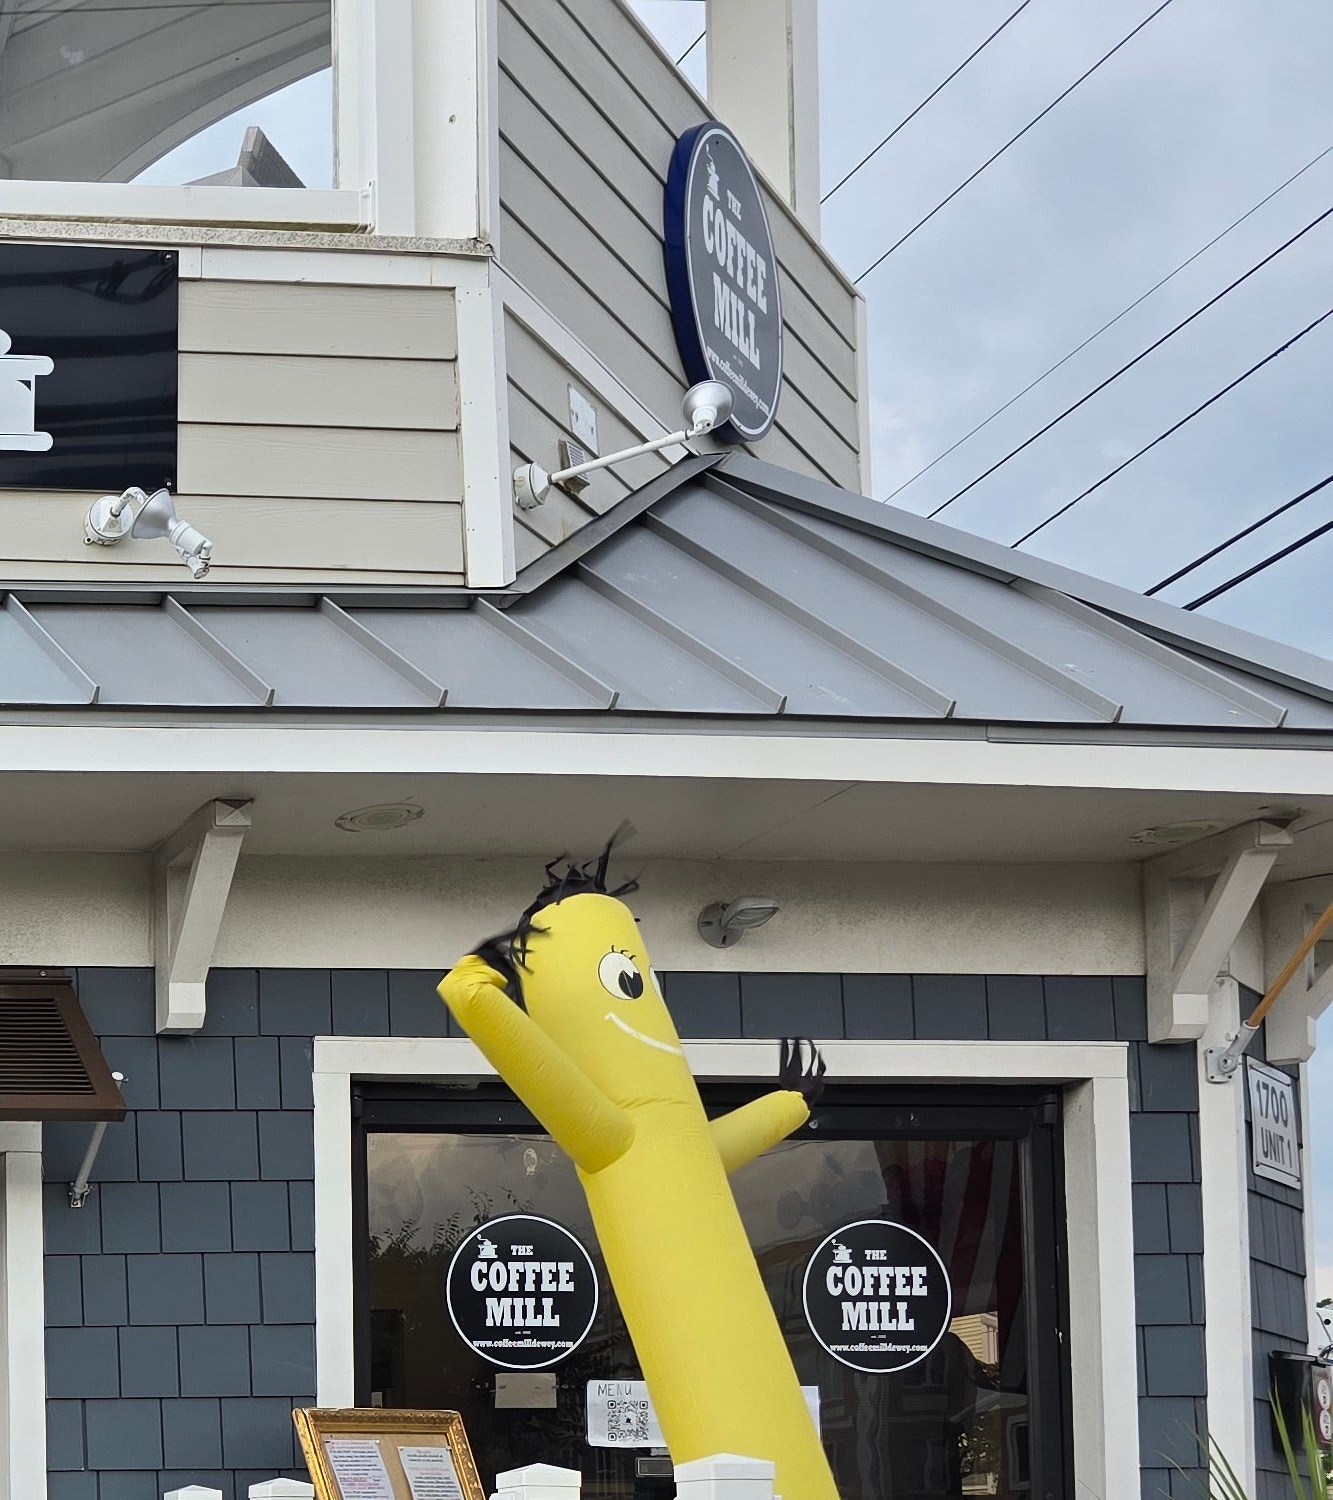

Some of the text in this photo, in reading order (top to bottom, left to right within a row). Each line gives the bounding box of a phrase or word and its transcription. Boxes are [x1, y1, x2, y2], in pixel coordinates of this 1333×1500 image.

[726, 188, 742, 221] THE
[702, 194, 768, 315] COFFEE
[712, 271, 761, 371] MILL
[1256, 1079, 1289, 1128] 1700
[1261, 1127, 1293, 1169] UNIT 1
[510, 1245, 534, 1255] THE
[864, 1250, 887, 1260] THE
[470, 1260, 575, 1292] COFFEE
[826, 1265, 928, 1296] COFFEE
[485, 1297, 560, 1327] MILL
[841, 1301, 915, 1331] MILL
[597, 1384, 632, 1397] MENU
